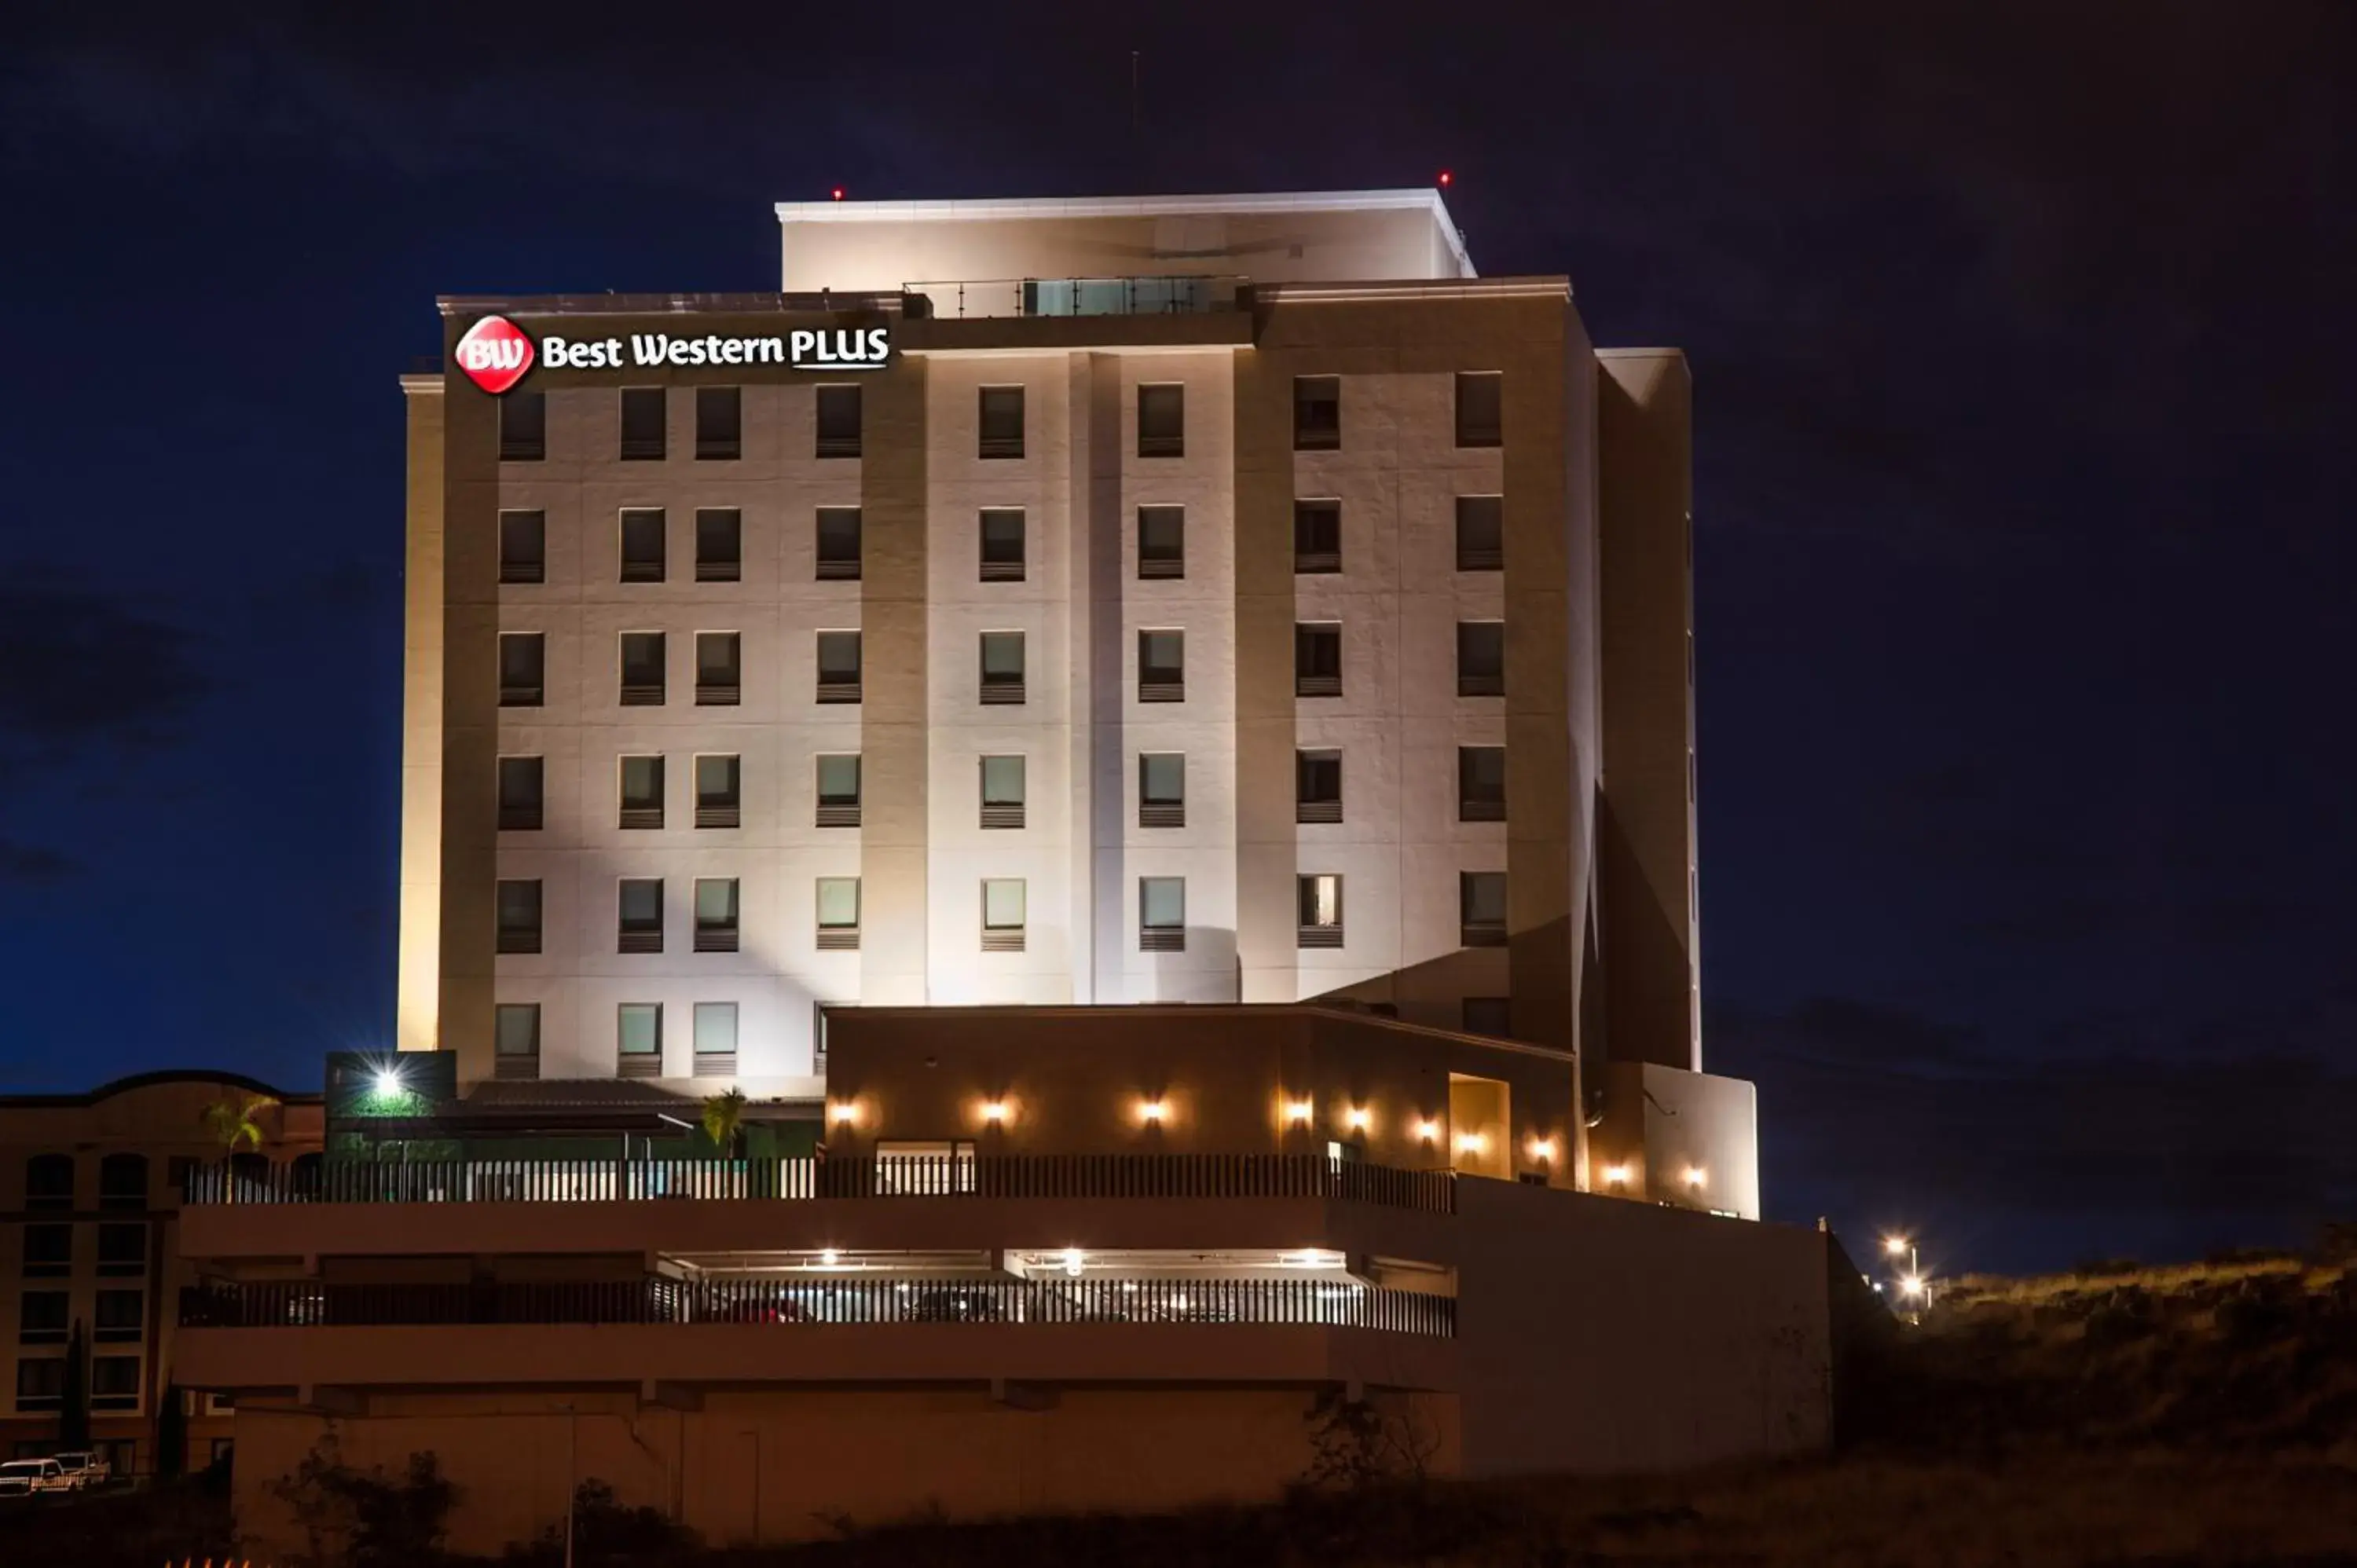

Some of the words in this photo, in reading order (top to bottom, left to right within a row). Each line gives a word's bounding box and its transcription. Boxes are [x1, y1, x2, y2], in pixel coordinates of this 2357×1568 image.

[466, 337, 525, 371] BW
[543, 336, 623, 368] Best
[631, 332, 784, 366] Western
[792, 328, 889, 362] PLUS
